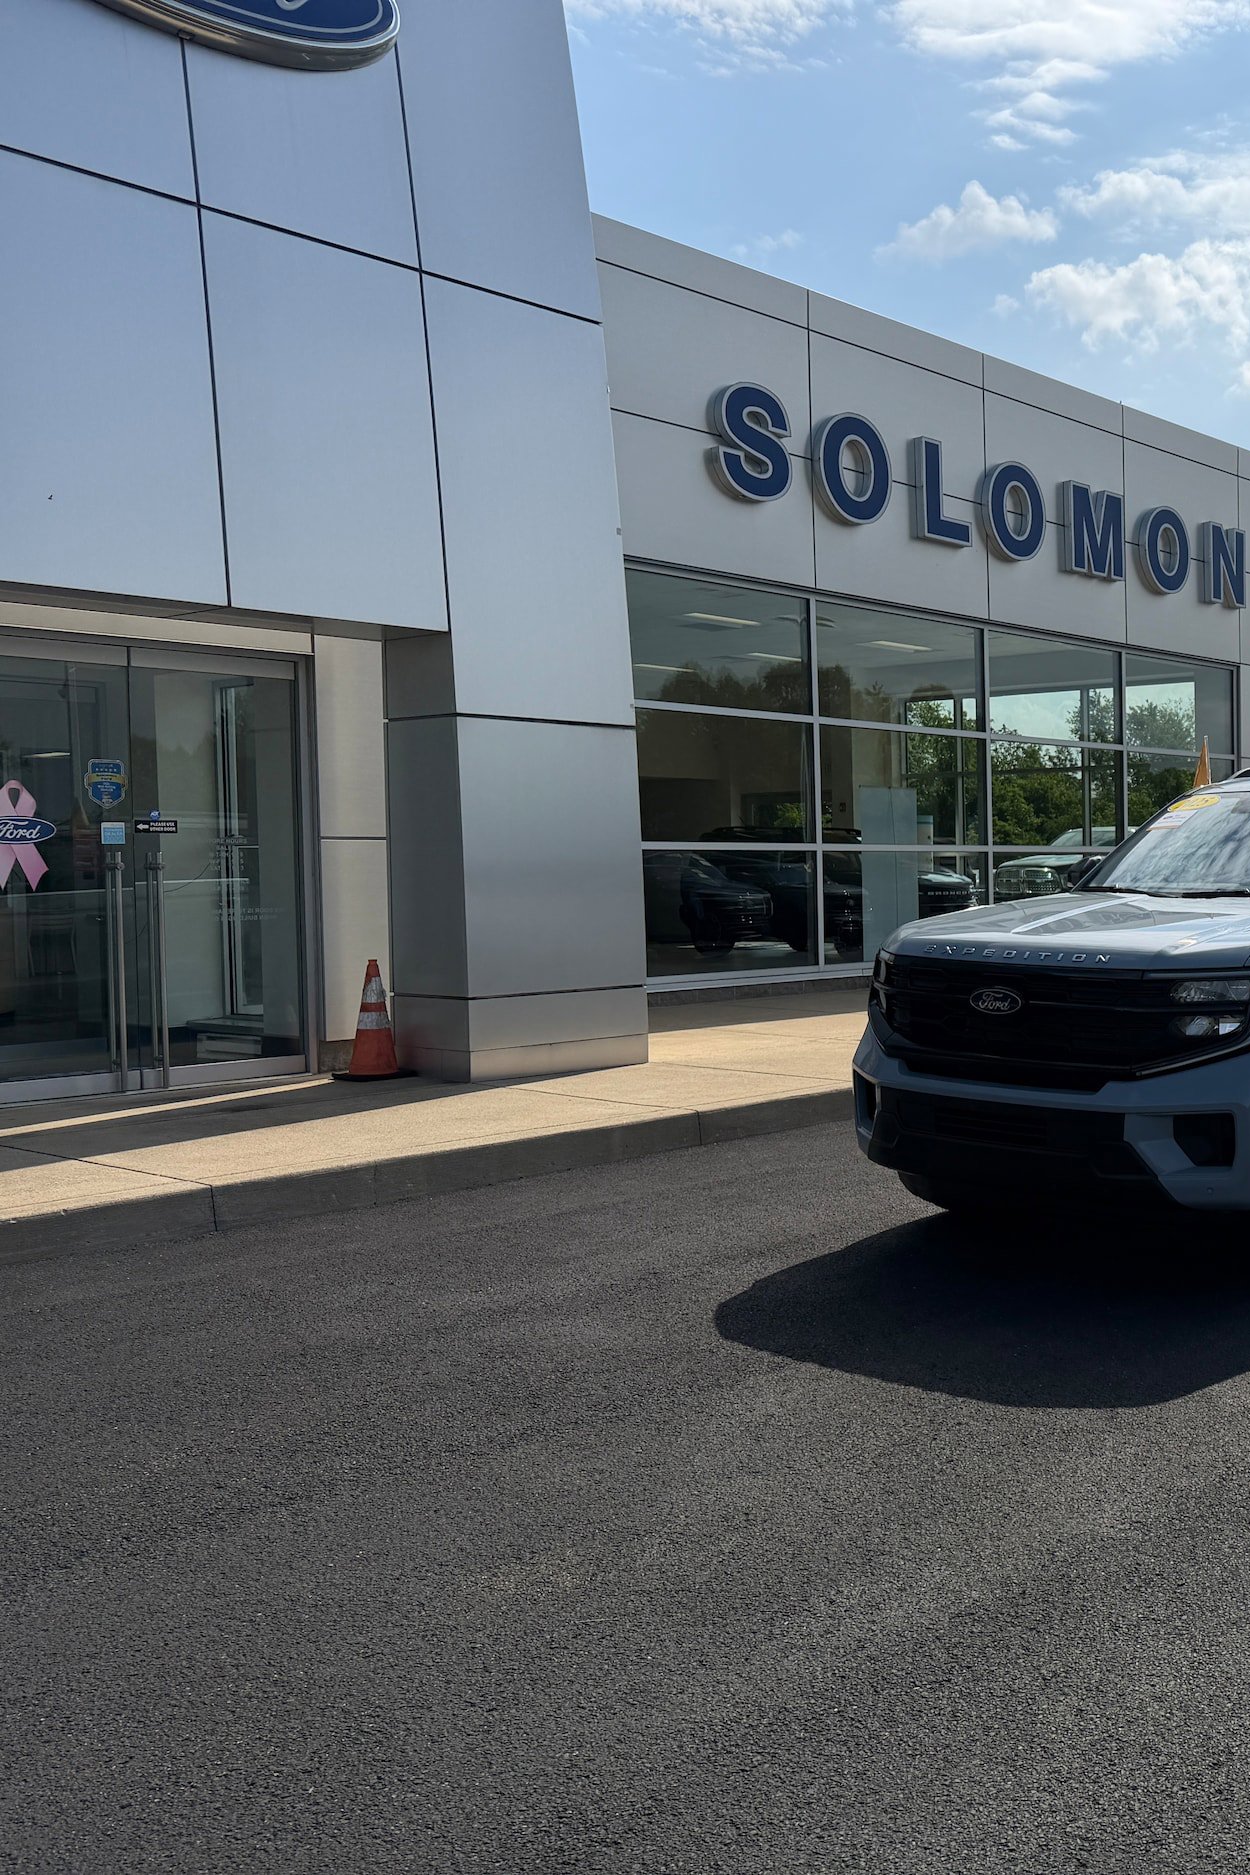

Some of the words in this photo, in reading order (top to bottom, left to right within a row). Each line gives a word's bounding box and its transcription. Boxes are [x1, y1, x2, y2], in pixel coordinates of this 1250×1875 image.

[709, 381, 1247, 608] SOLOMON
[0, 820, 41, 839] Ford
[925, 944, 1111, 963] EXPEDITION
[978, 991, 1012, 1011] Ford
